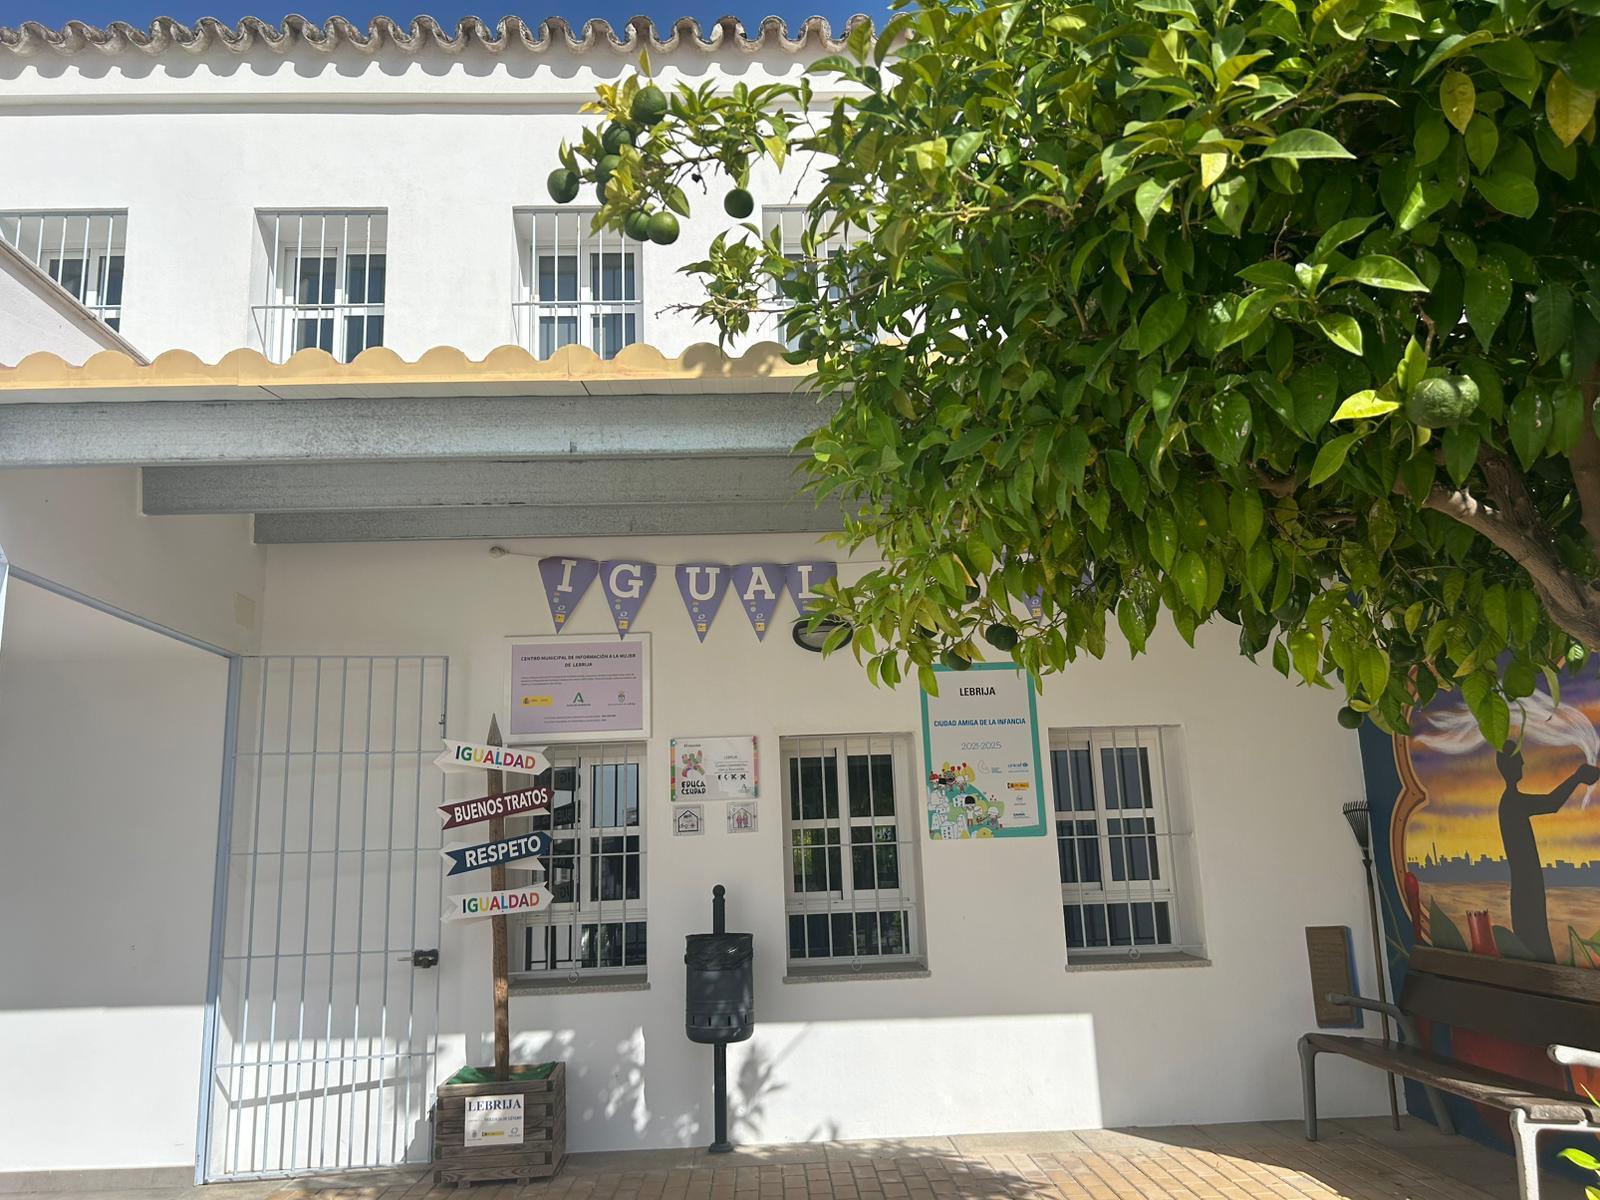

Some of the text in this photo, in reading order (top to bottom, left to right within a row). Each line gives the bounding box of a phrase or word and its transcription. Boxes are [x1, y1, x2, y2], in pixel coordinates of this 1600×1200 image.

[959, 687, 996, 696] LEBRIJA
[997, 718, 1026, 726] INFANCIA
[961, 741, 1002, 750] 2021-2025
[455, 745, 536, 769] IGUALDAD
[681, 780, 706, 788] EDUCA
[454, 787, 548, 823] BUENOS TRATOS
[465, 835, 541, 868] RESPETO
[462, 892, 540, 913] IGUALDAD
[468, 1099, 521, 1112] LEBRIJA
